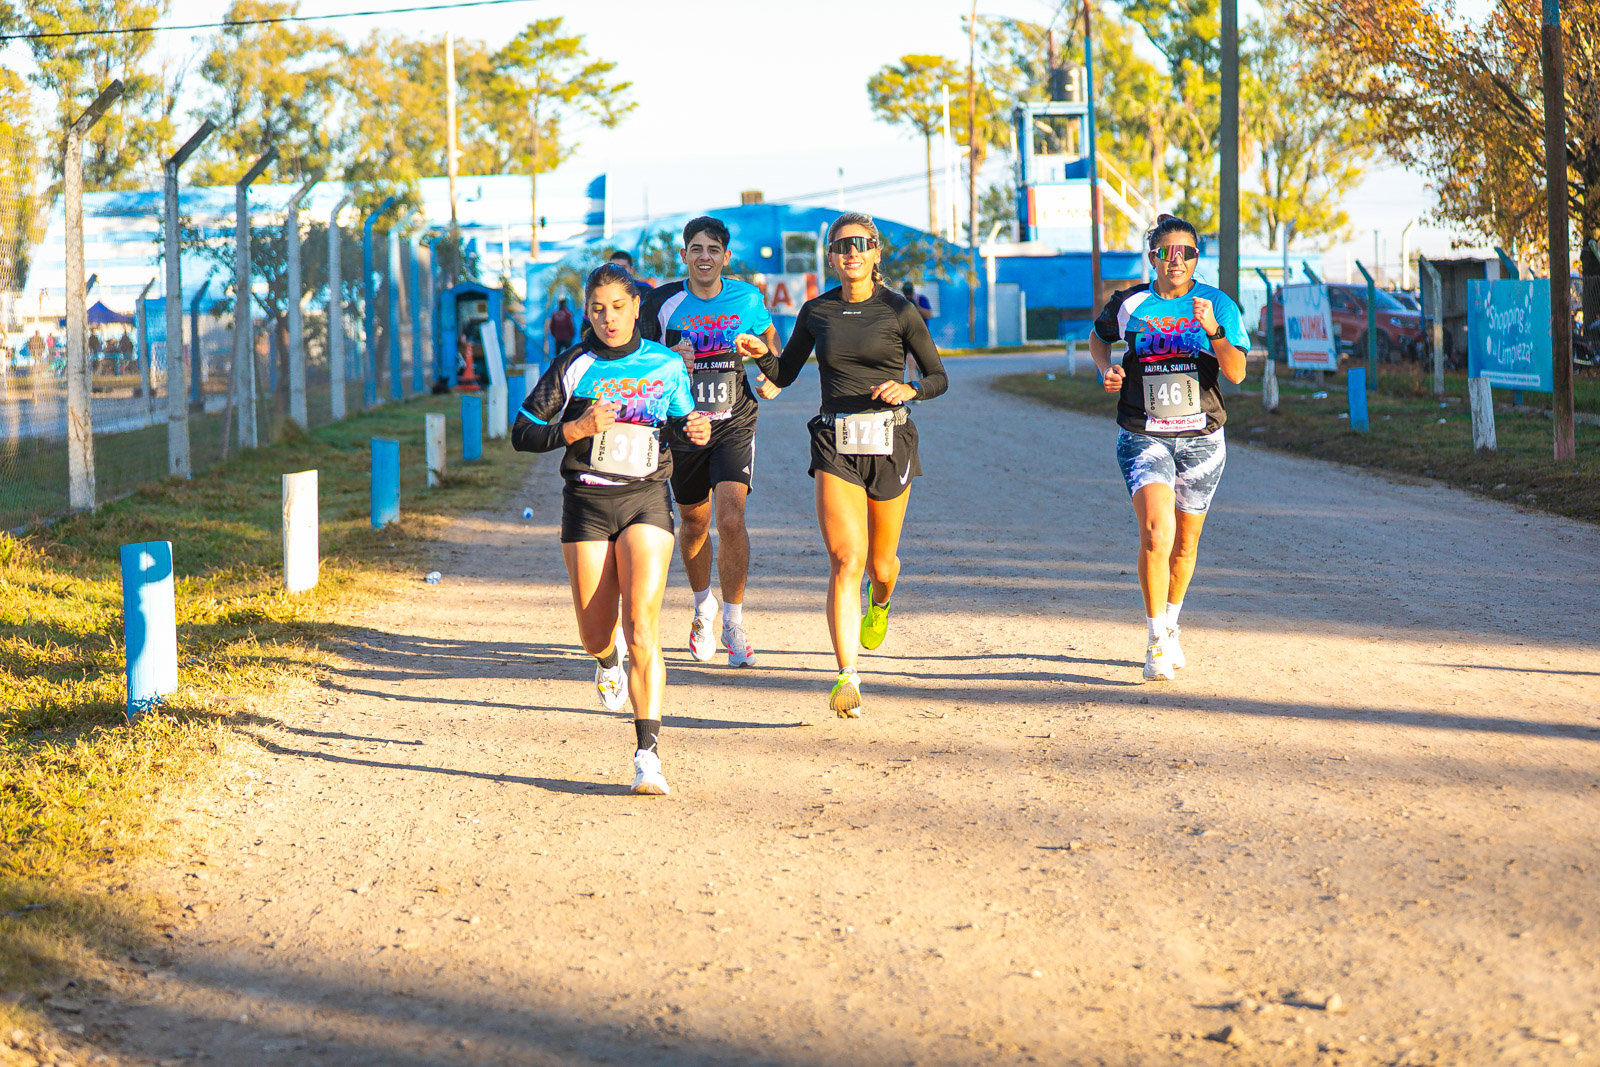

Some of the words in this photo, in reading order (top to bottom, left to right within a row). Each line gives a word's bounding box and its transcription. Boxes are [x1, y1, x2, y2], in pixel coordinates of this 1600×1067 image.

[1489, 302, 1524, 335] Shopping
[1135, 333, 1196, 355] RUN
[1498, 337, 1531, 369] Limpieza
[710, 361, 729, 369] SANTA
[729, 360, 735, 368] FE
[1170, 363, 1190, 372] SANTA
[697, 382, 728, 403] 113
[1157, 383, 1182, 406] 46
[848, 420, 884, 445] 172
[611, 433, 642, 464] 31
